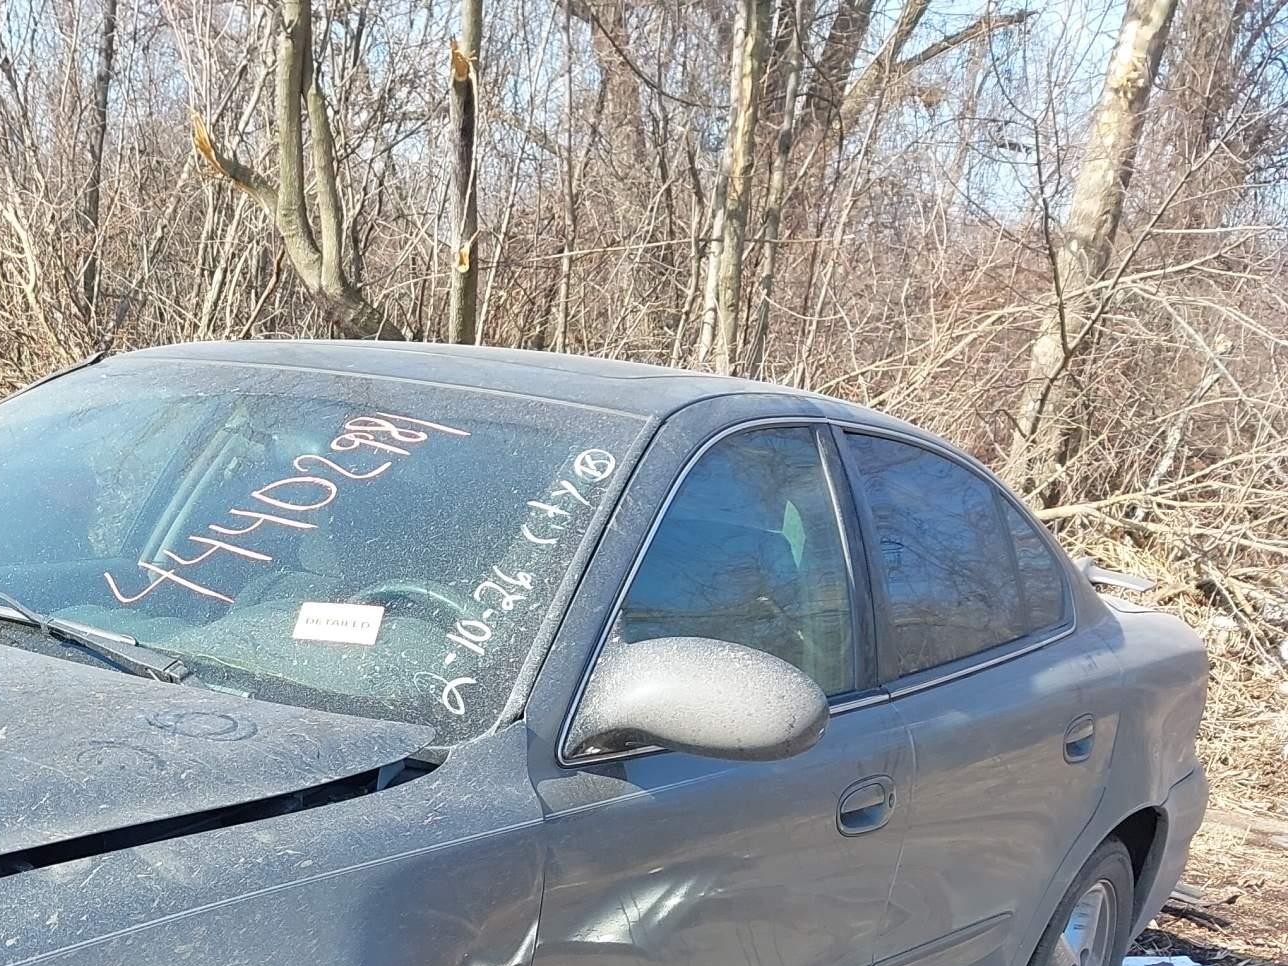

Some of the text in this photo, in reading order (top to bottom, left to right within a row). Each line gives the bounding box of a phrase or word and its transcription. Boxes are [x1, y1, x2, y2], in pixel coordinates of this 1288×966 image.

[103, 411, 472, 604] 44402981
[305, 617, 371, 630] DETAILED
[413, 564, 533, 715] 2-10-26
